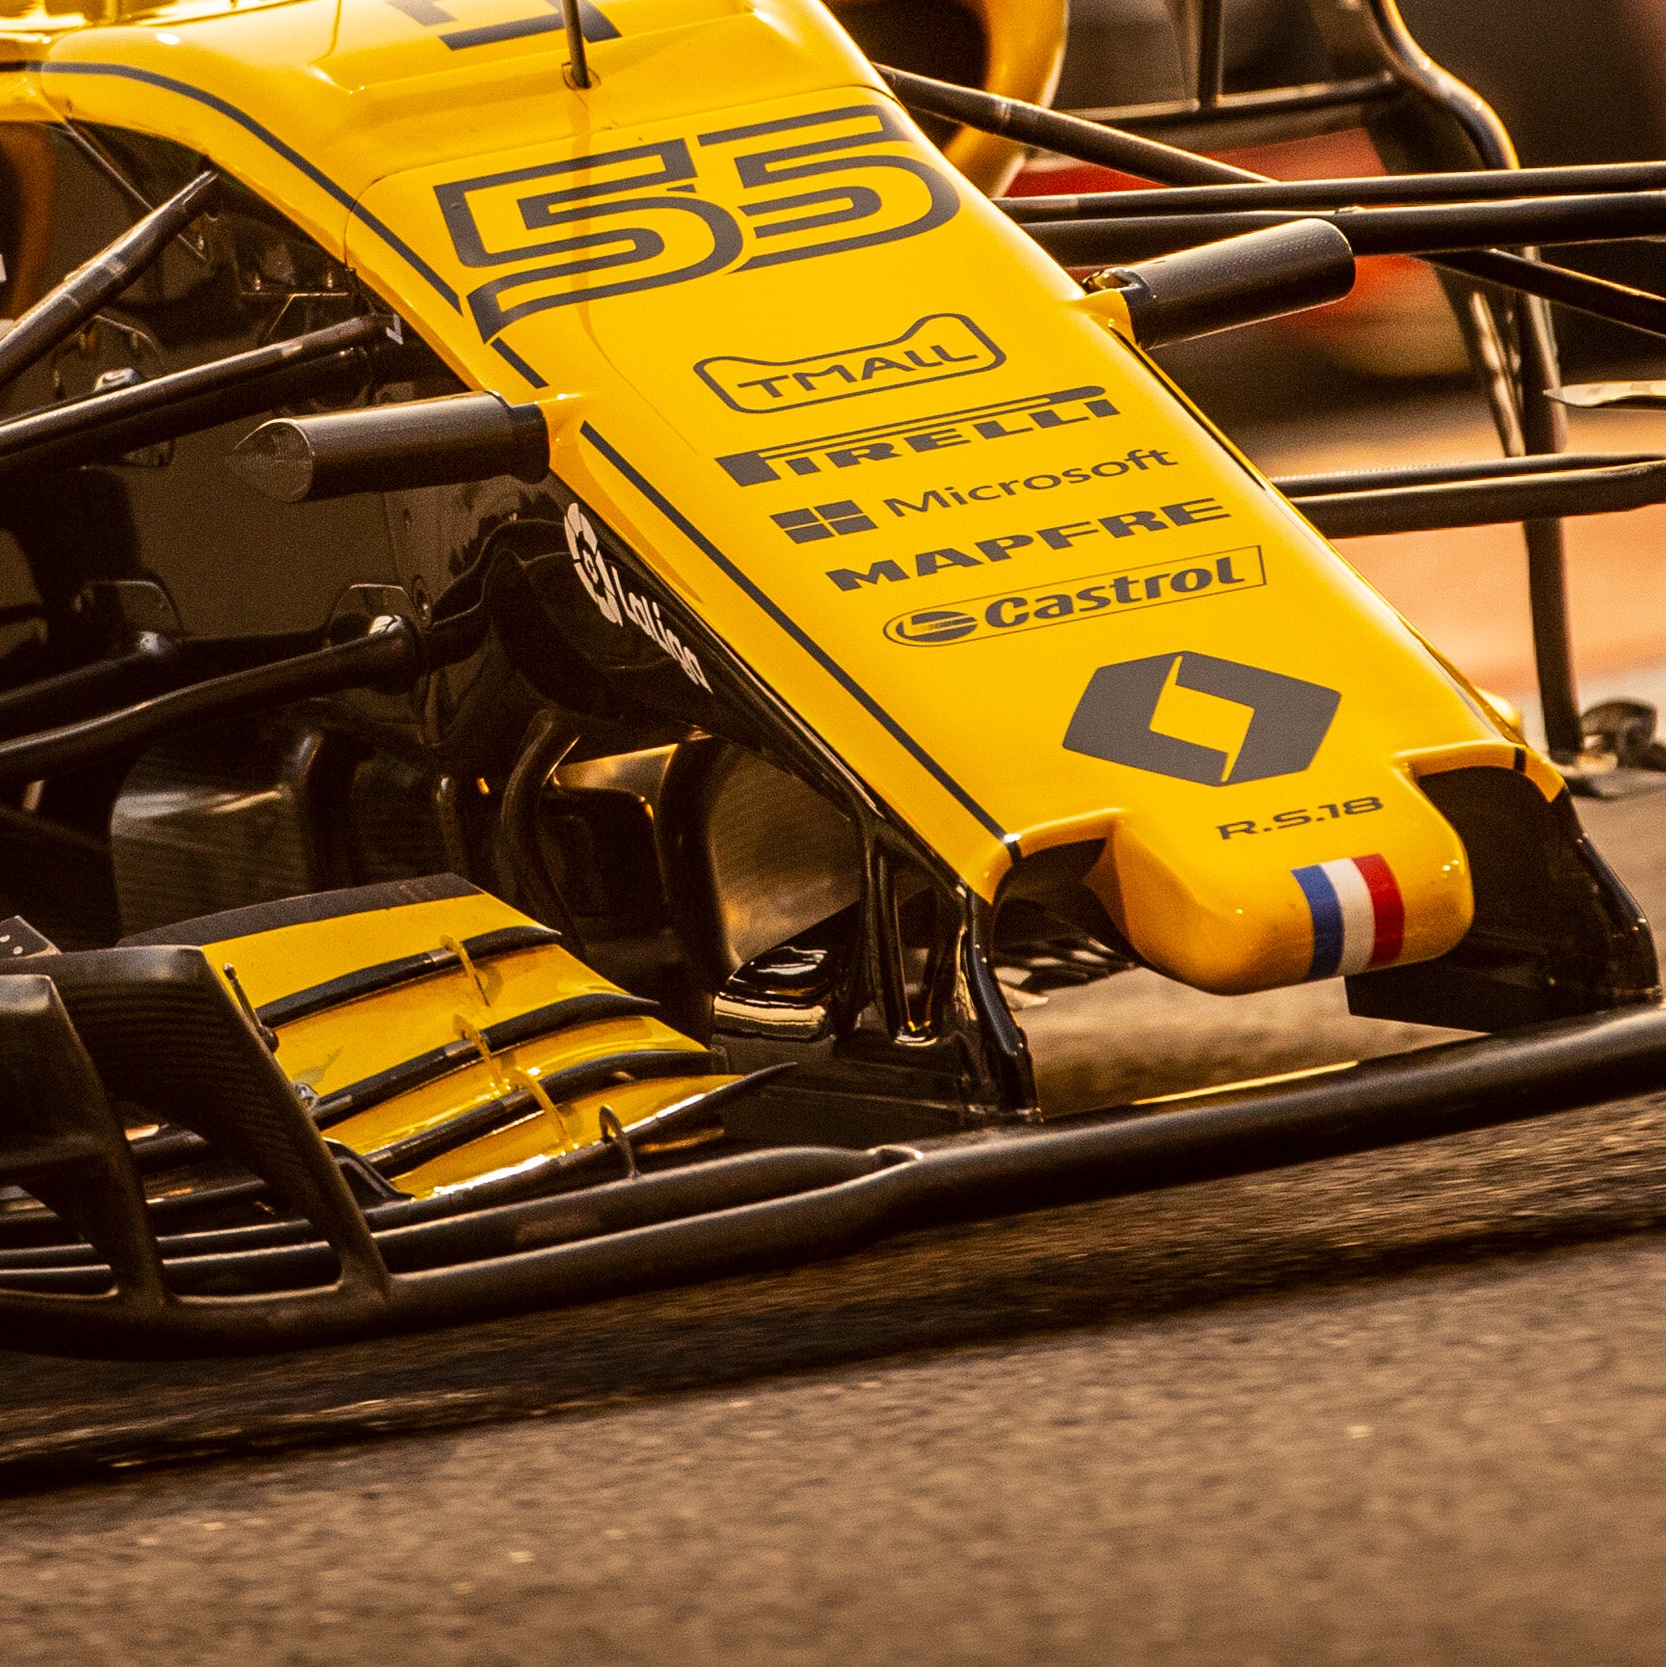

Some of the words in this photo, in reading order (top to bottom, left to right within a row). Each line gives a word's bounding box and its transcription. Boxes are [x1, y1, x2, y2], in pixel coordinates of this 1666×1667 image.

[431, 103, 962, 345] 55
[737, 344, 979, 399] TMALL
[713, 384, 1122, 488] PIRELLI
[882, 447, 1179, 518] Microsoft
[824, 496, 1232, 593] MAPFRE
[983, 555, 1247, 629] Castrol
[1216, 795, 1386, 841] R.S.18
